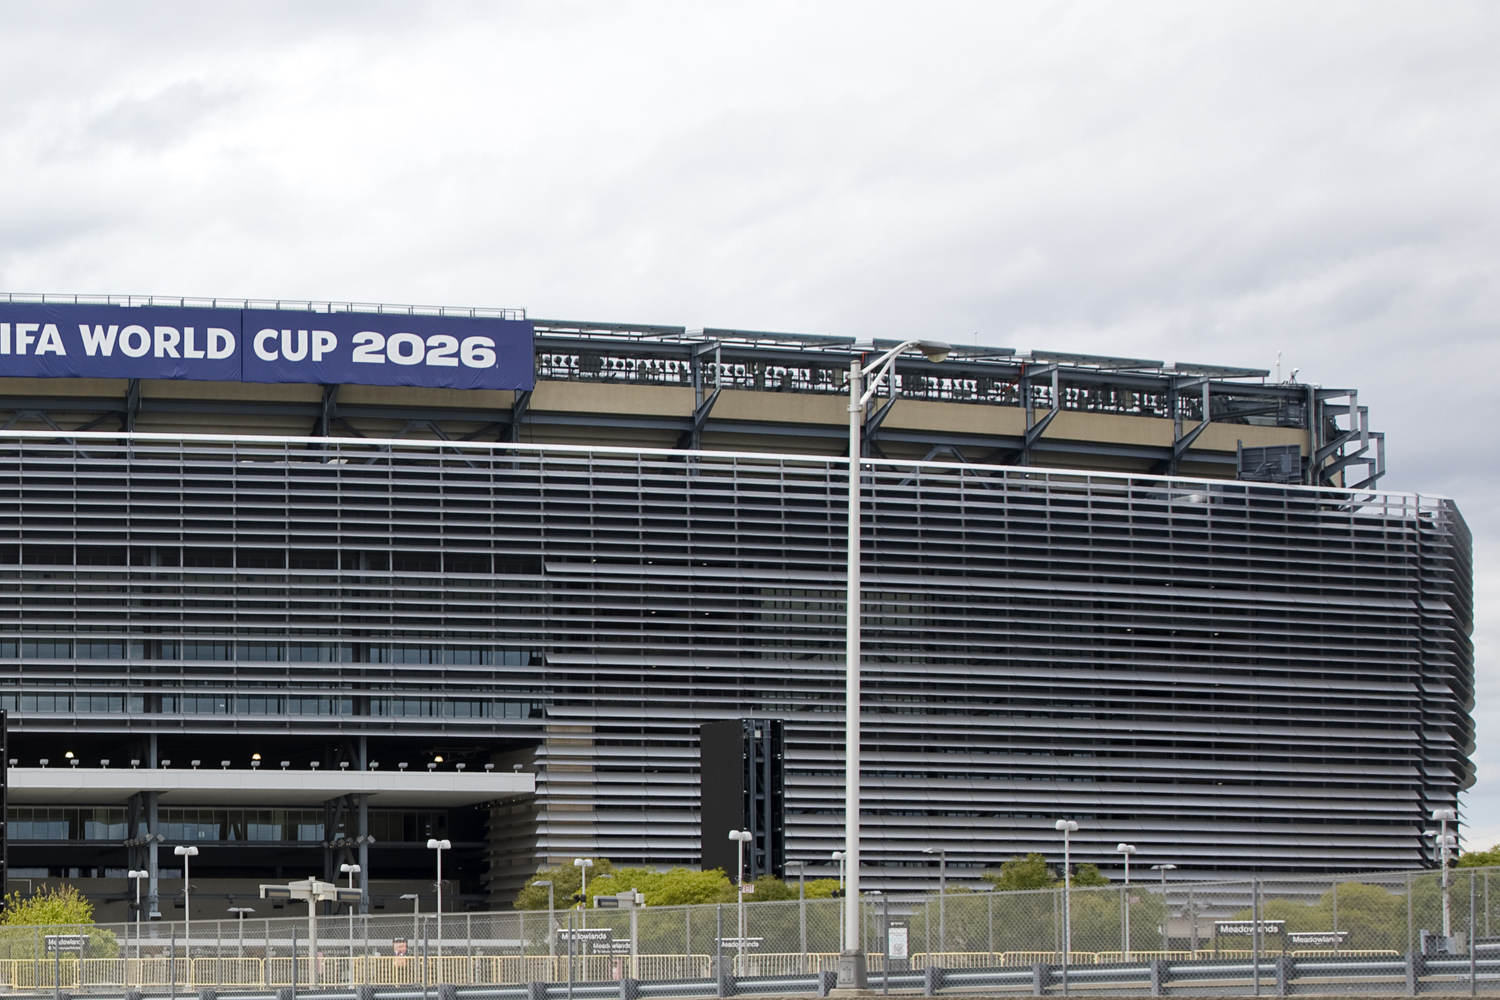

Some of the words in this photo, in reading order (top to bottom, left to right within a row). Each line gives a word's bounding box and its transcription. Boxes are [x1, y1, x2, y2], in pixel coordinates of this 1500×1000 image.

[78, 324, 236, 359] WORLD
[253, 328, 338, 361] CUP
[352, 331, 497, 368] 2026
